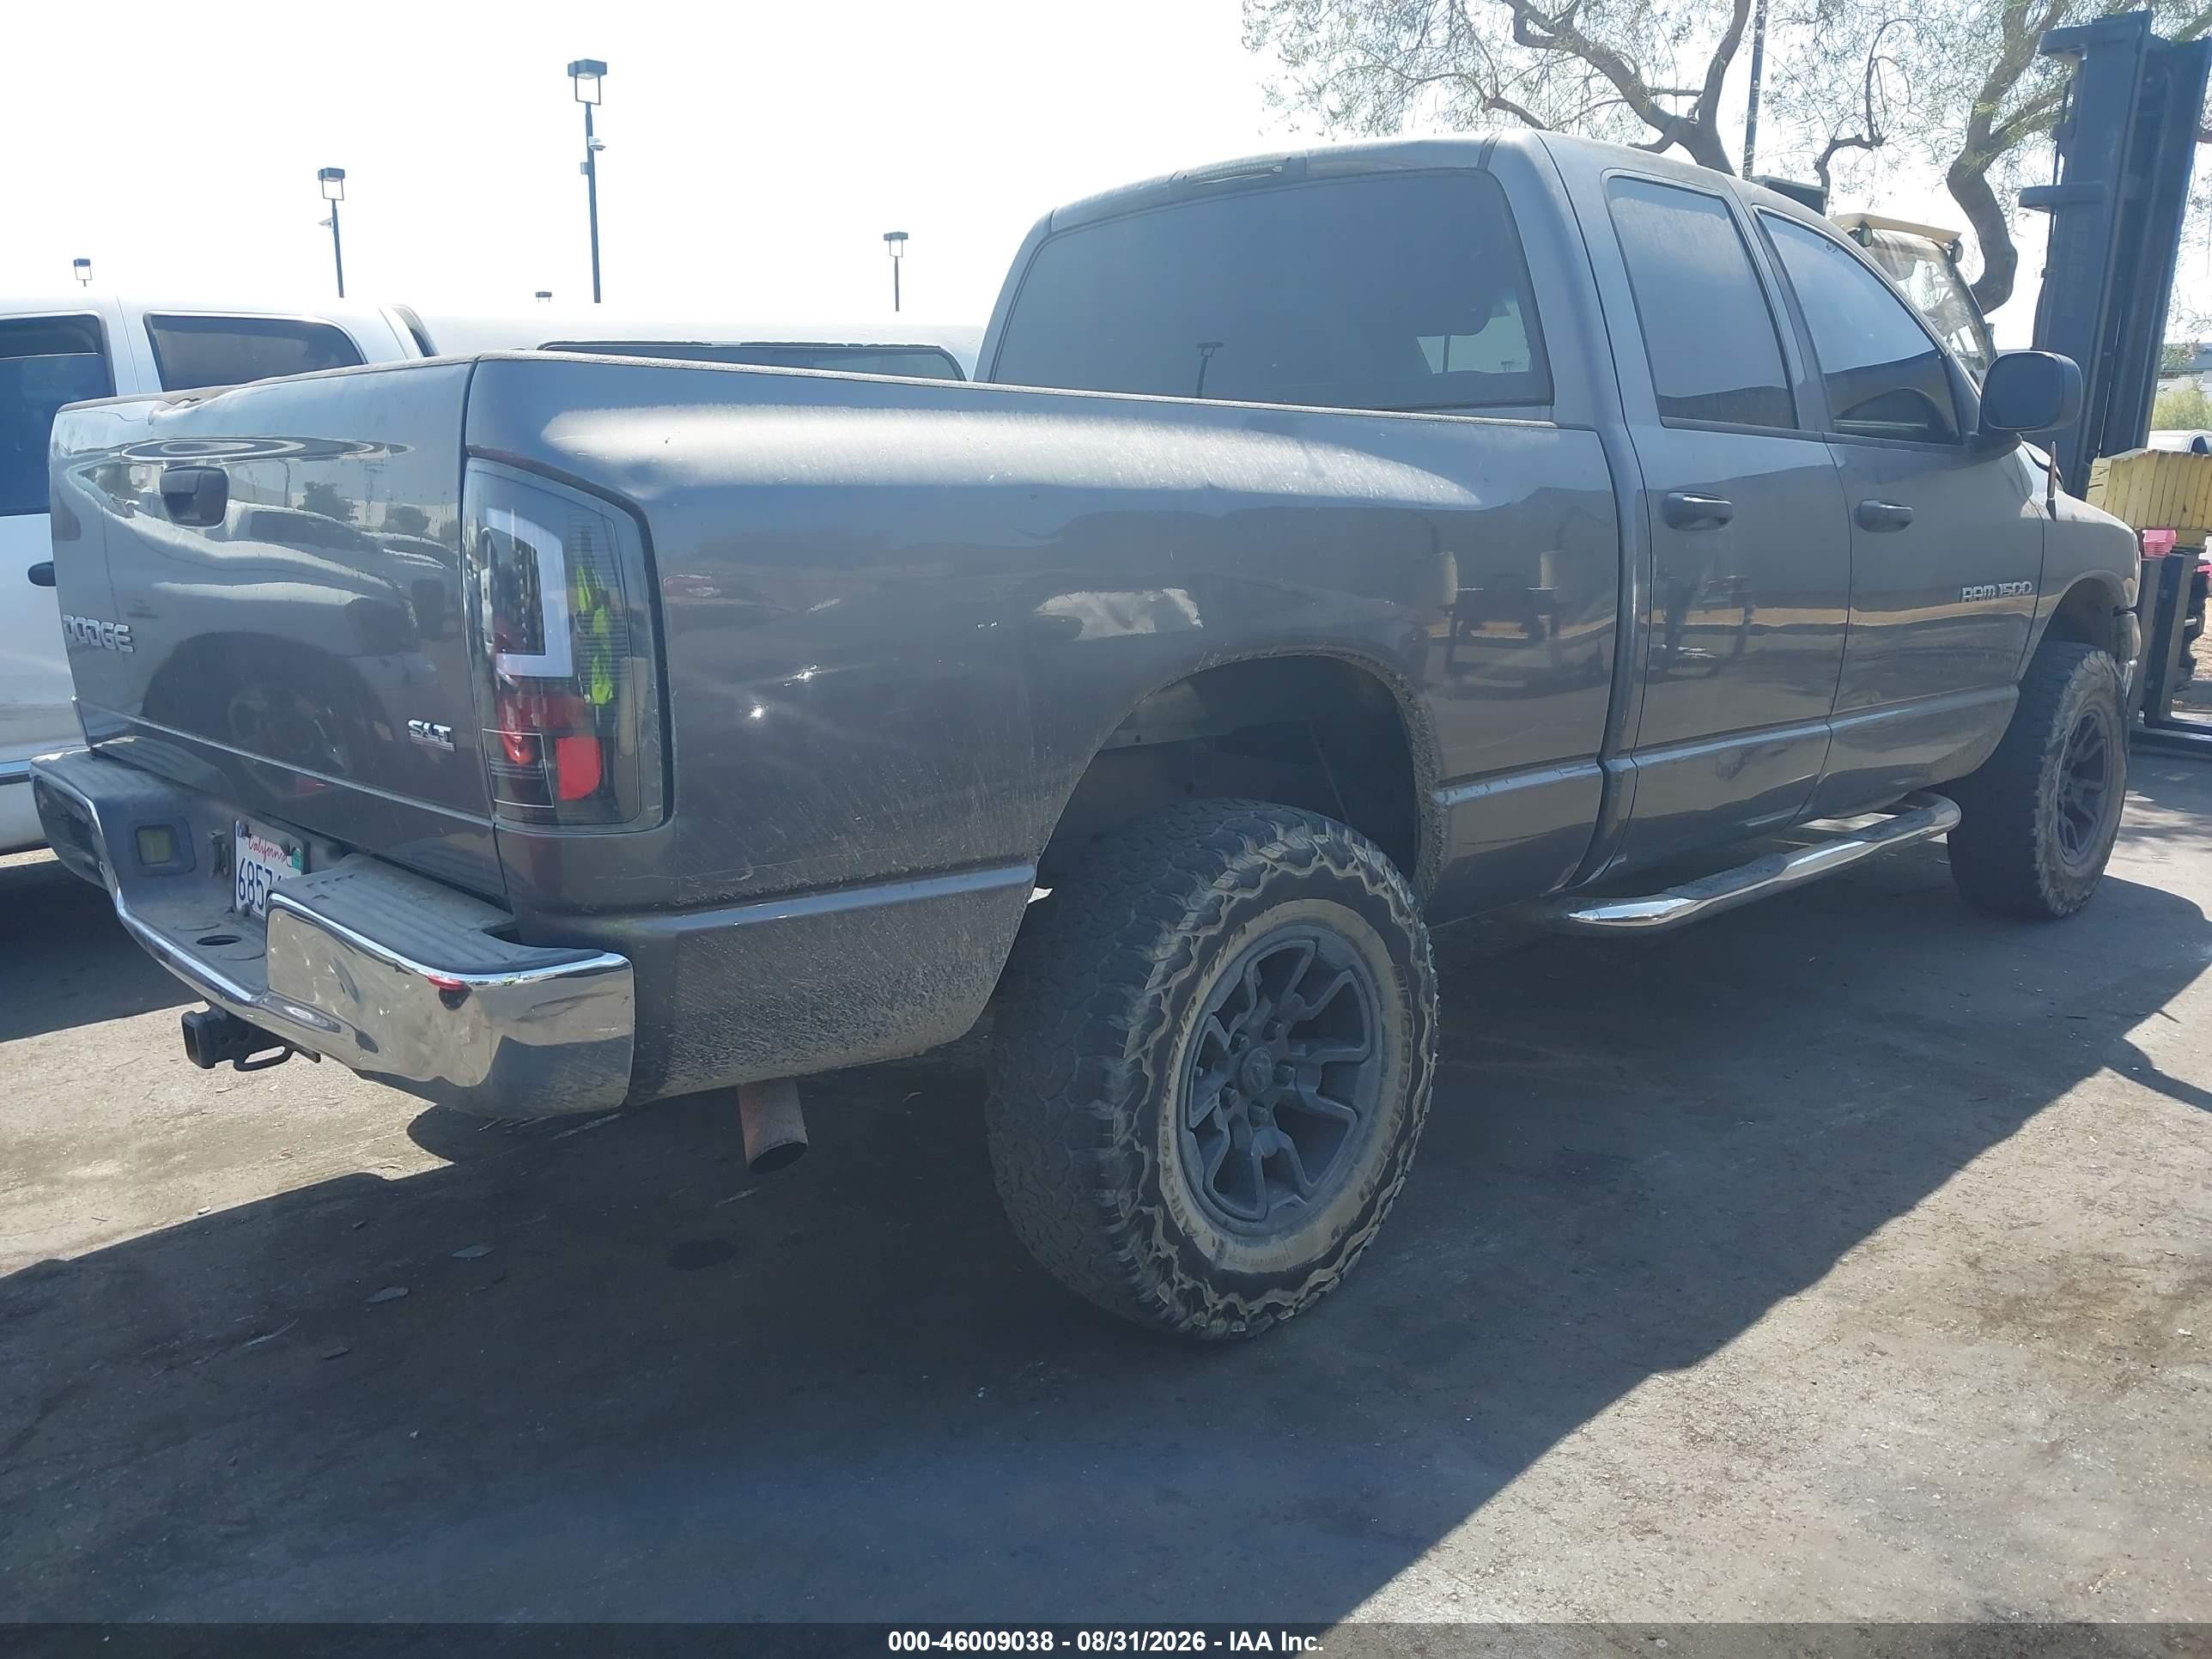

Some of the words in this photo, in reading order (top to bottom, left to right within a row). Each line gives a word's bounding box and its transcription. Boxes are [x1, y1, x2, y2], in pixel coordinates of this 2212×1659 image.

[1961, 586, 1996, 603] RAM
[1997, 580, 2033, 598] 1500
[408, 720, 453, 746] SLT
[238, 857, 282, 911] 6857
